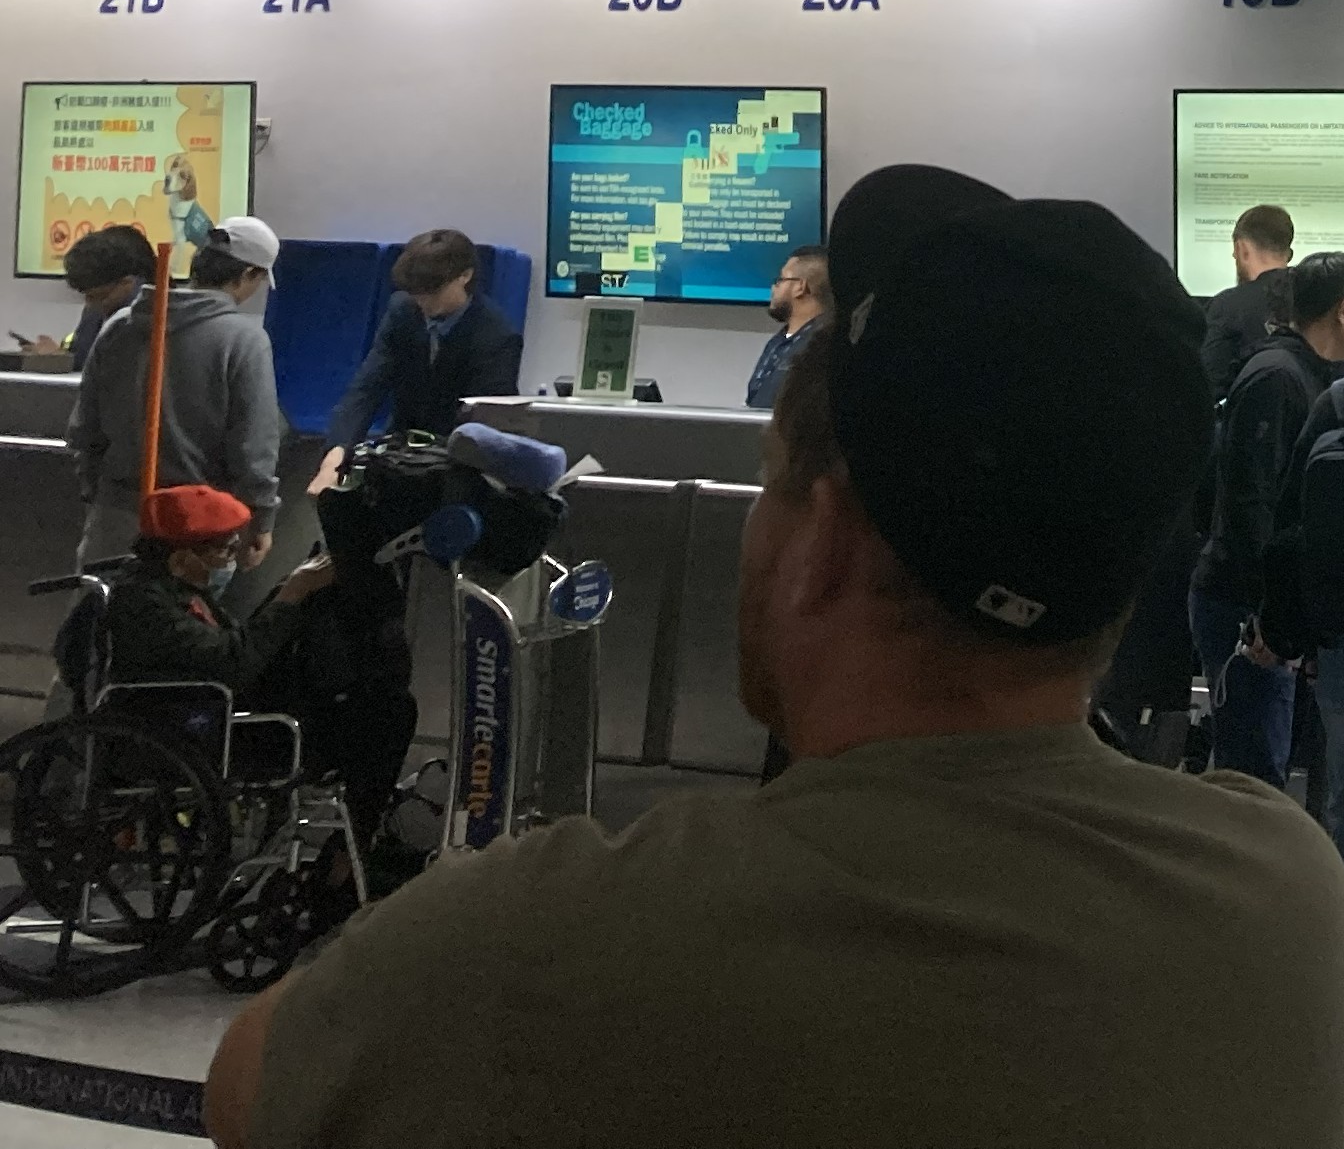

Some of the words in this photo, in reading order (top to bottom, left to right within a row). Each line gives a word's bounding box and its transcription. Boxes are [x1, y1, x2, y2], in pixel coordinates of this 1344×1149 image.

[573, 102, 645, 122] Checked
[579, 119, 653, 141] Baggage
[736, 123, 758, 138] Only
